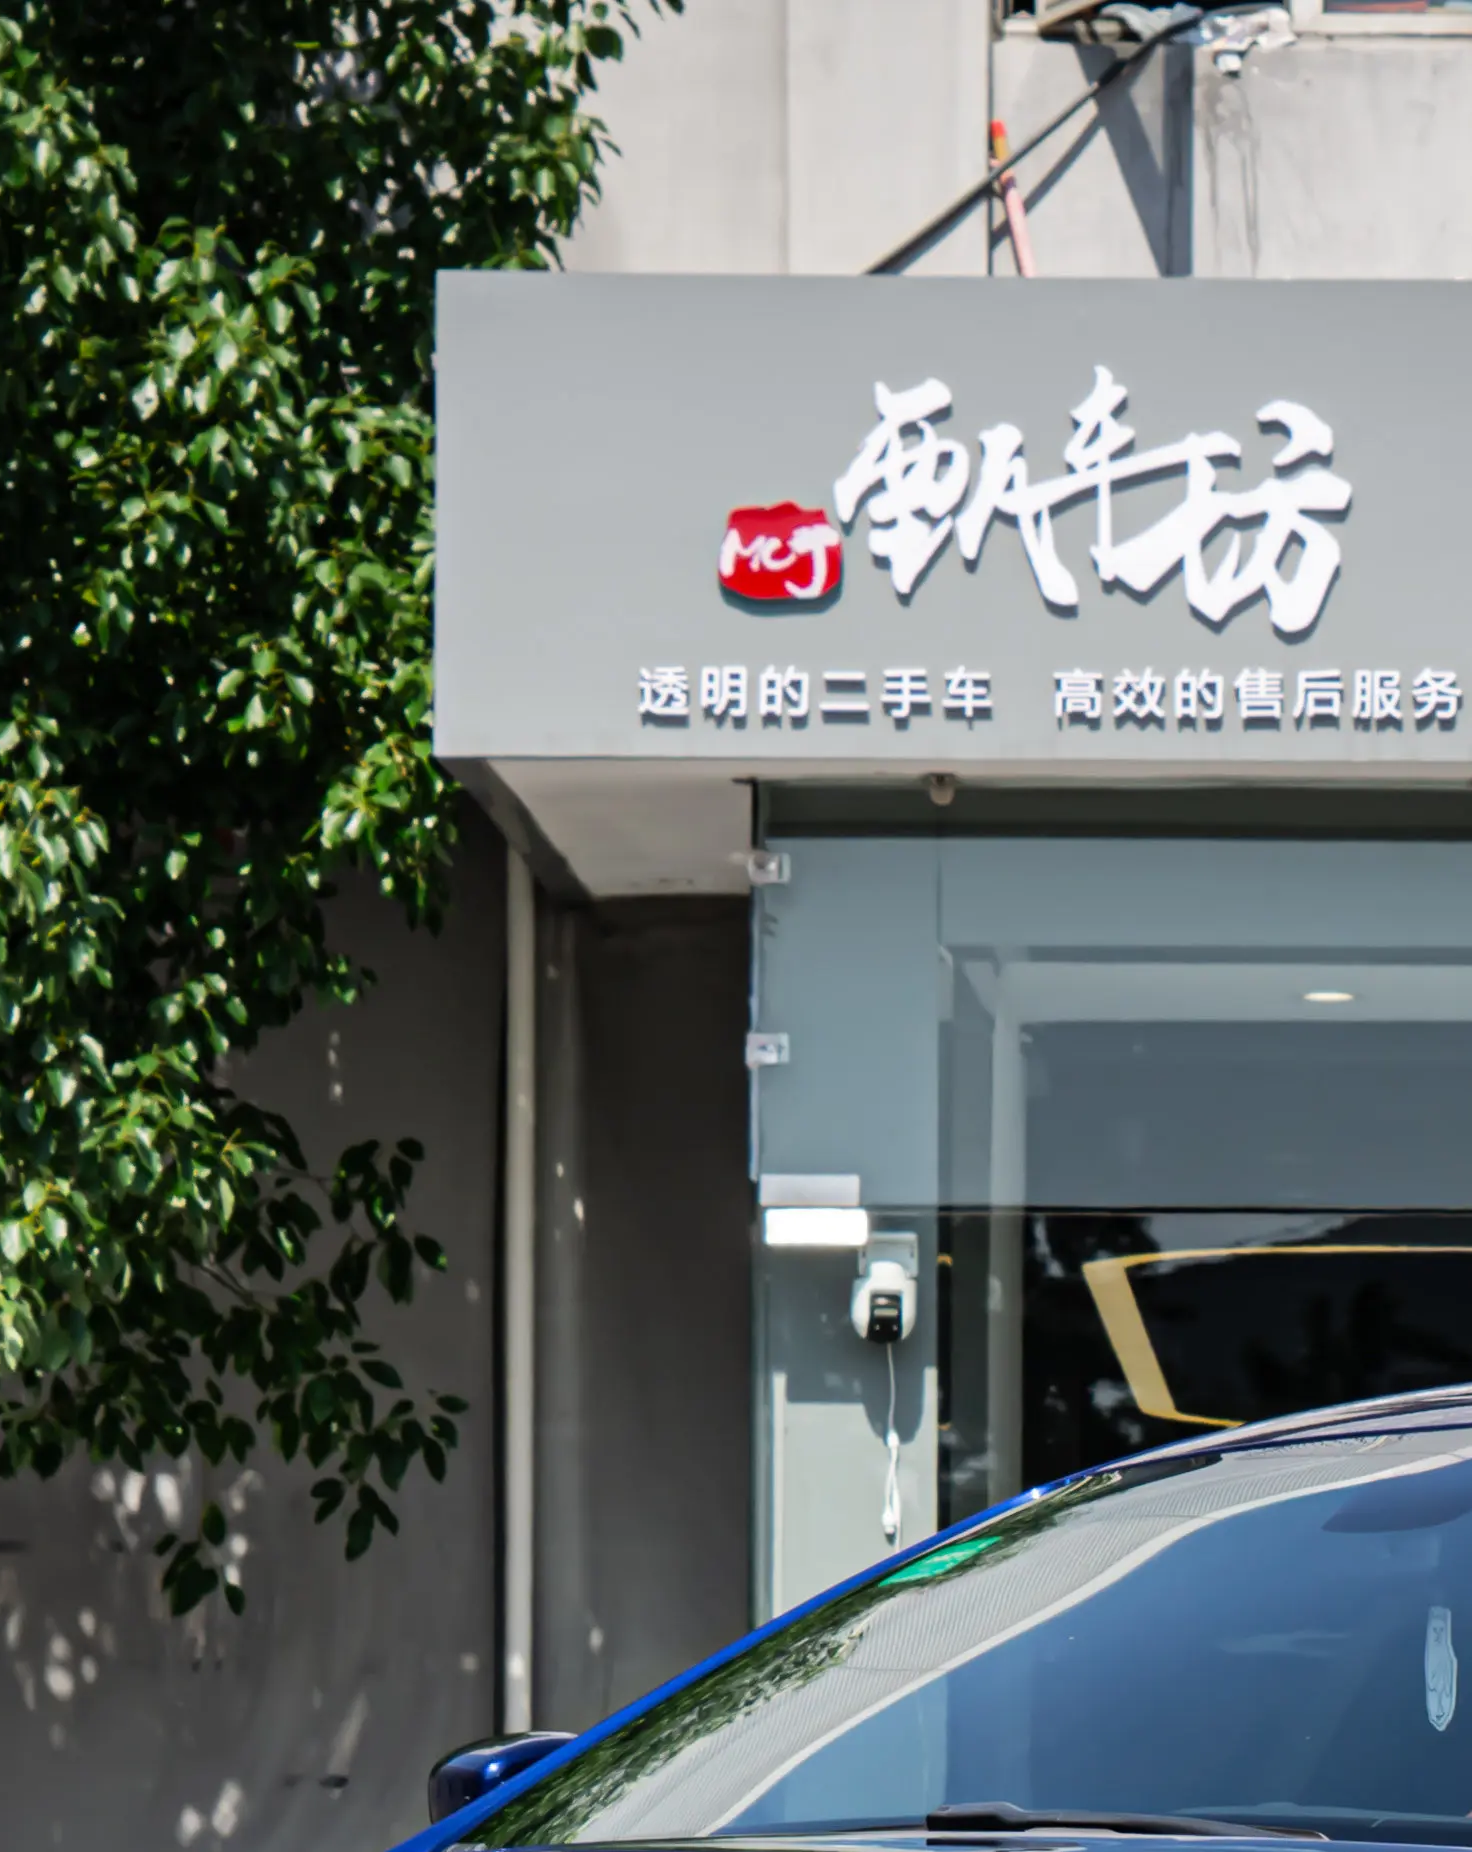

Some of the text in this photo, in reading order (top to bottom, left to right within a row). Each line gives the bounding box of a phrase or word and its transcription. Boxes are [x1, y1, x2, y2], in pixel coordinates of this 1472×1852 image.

[639, 664, 1462, 719] 透明的二手车 高效的售后服务
